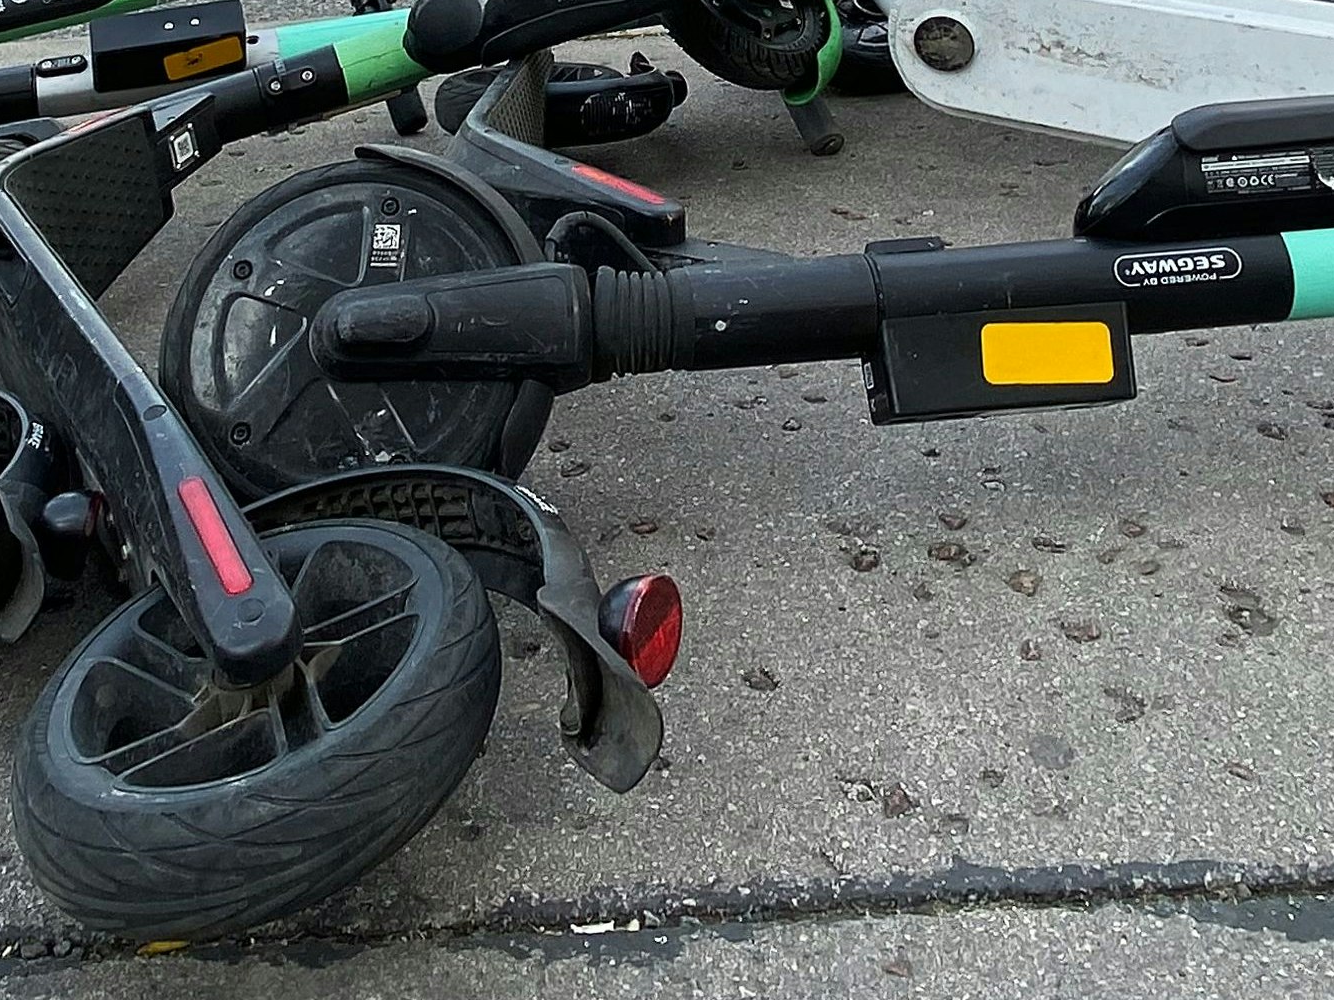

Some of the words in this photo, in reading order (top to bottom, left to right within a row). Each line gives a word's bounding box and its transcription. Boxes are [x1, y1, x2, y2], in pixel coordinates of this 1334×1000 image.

[1130, 254, 1226, 276] SEGWAY
[1143, 277, 1158, 287] BY
[1161, 273, 1217, 285] POWERED
